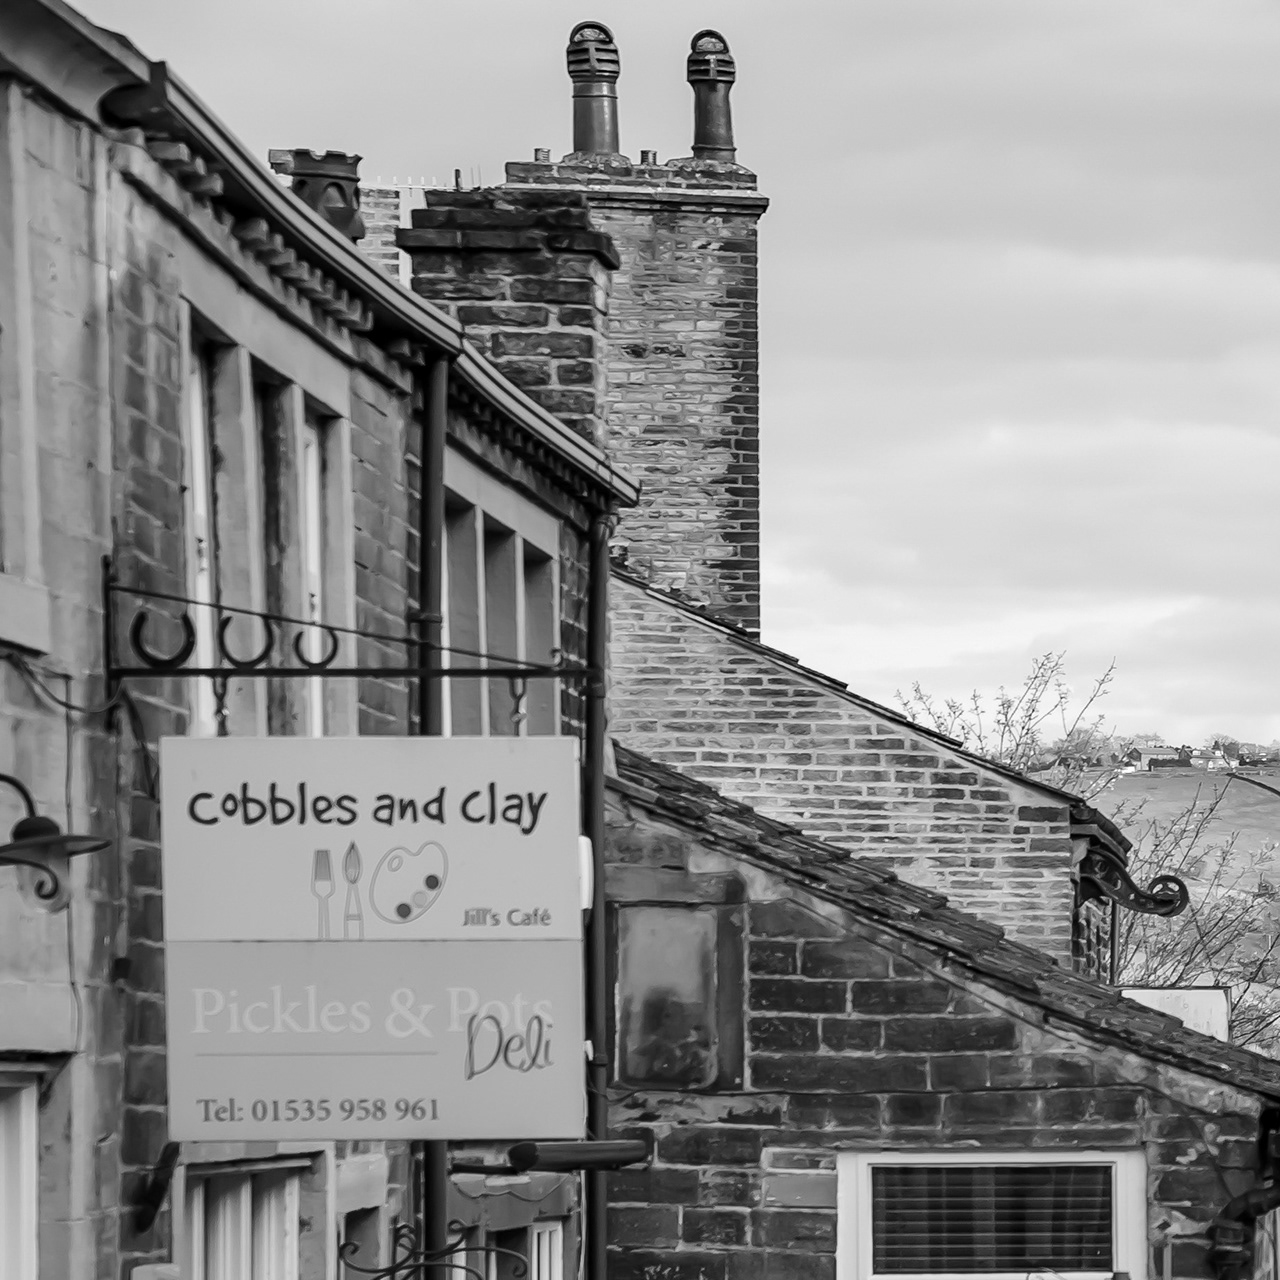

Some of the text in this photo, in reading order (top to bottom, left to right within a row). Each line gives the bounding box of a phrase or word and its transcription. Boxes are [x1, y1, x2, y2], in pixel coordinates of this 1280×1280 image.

[373, 786, 447, 828] and
[462, 906, 552, 927] Jill's Café
[190, 984, 555, 1040] Pickles & Pots
[464, 1012, 555, 1081] Deli
[194, 1097, 440, 1124] Tel: 01535 958 961
